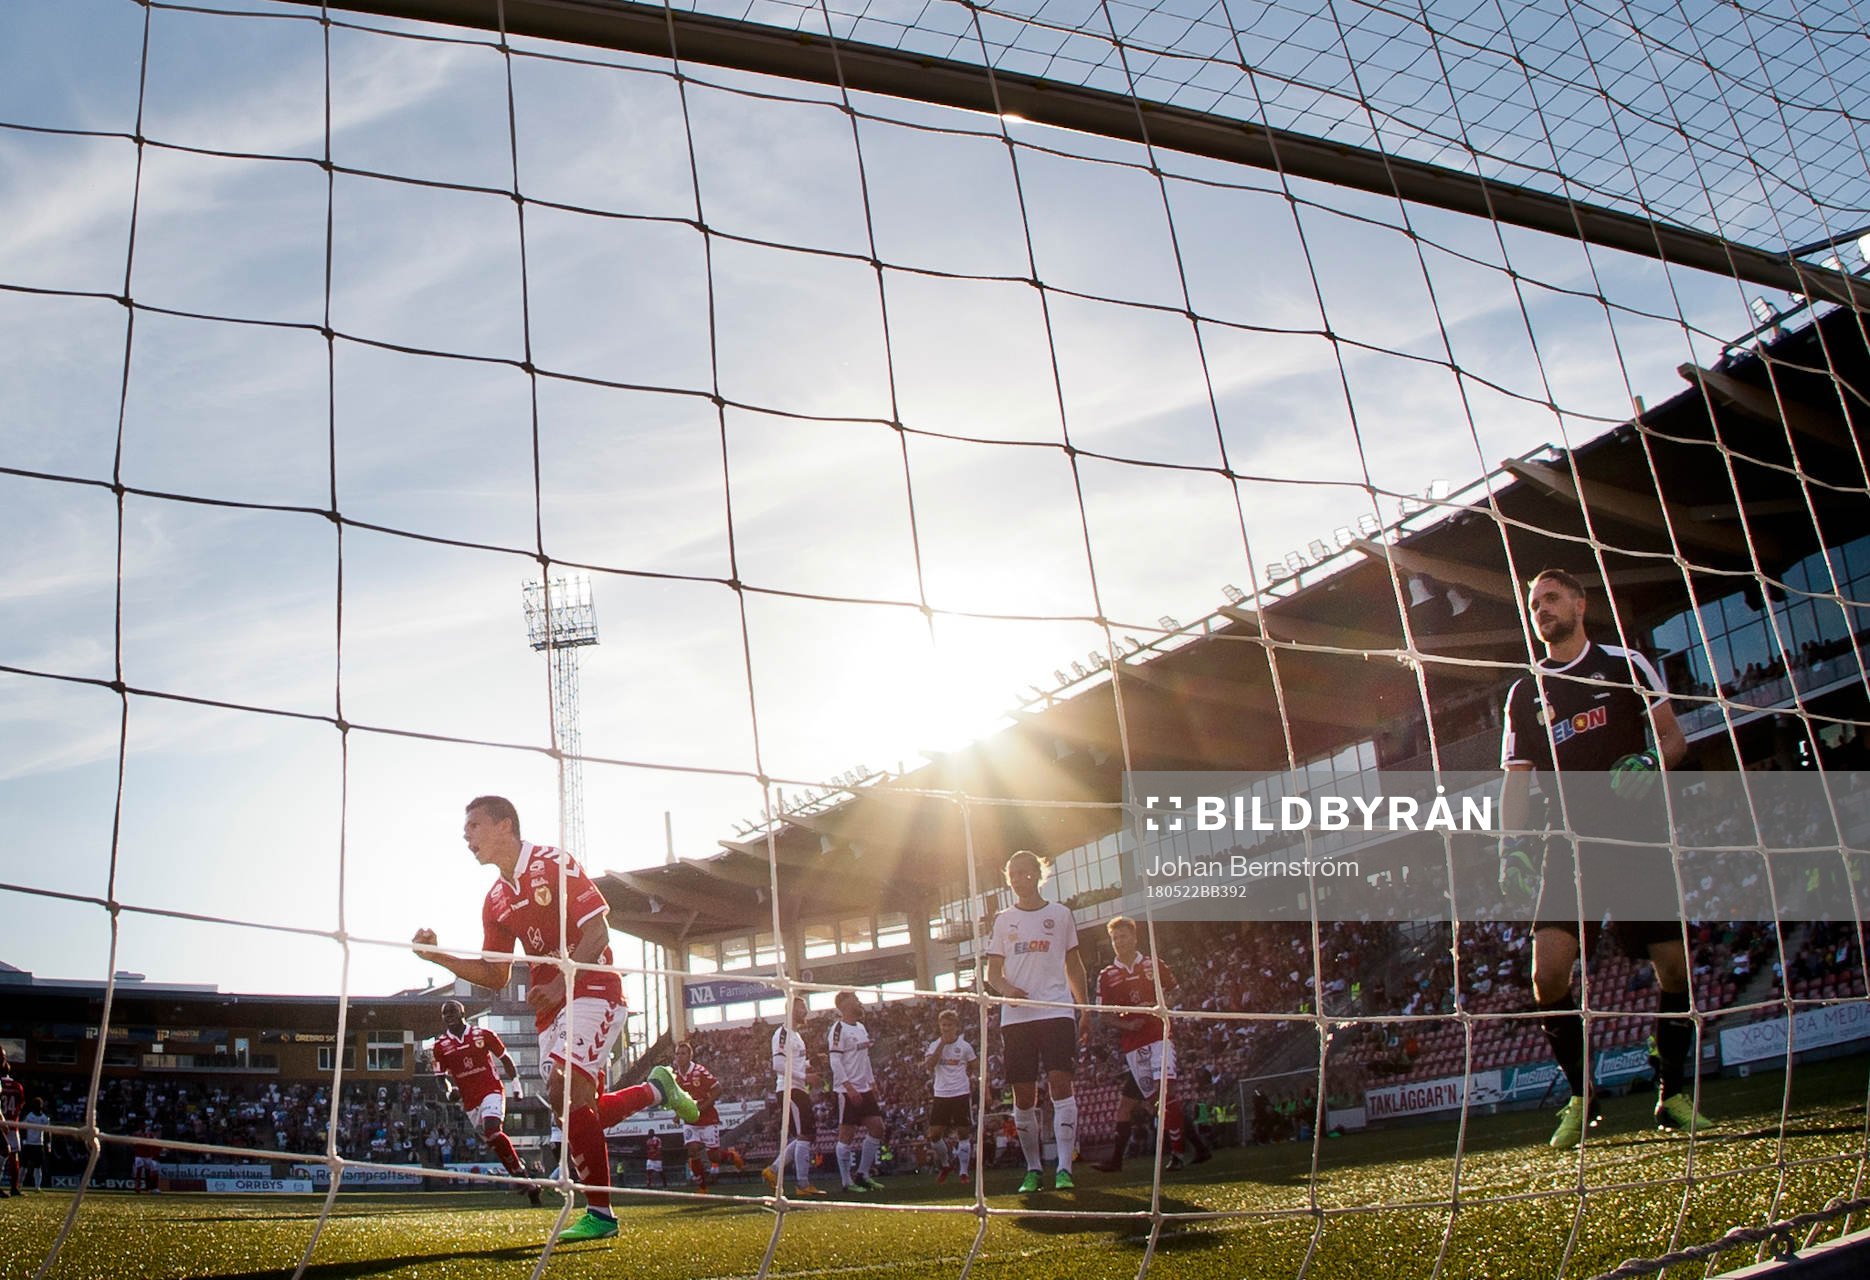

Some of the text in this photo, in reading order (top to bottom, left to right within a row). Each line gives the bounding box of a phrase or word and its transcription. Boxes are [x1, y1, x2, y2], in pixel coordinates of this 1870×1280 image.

[1551, 706, 1606, 745] ELON
[689, 986, 716, 1005] NA
[1741, 1016, 1818, 1046] XPONRA
[1369, 1083, 1457, 1116] TAKLÄGGAR'N
[235, 1177, 284, 1191] ORRBYS
